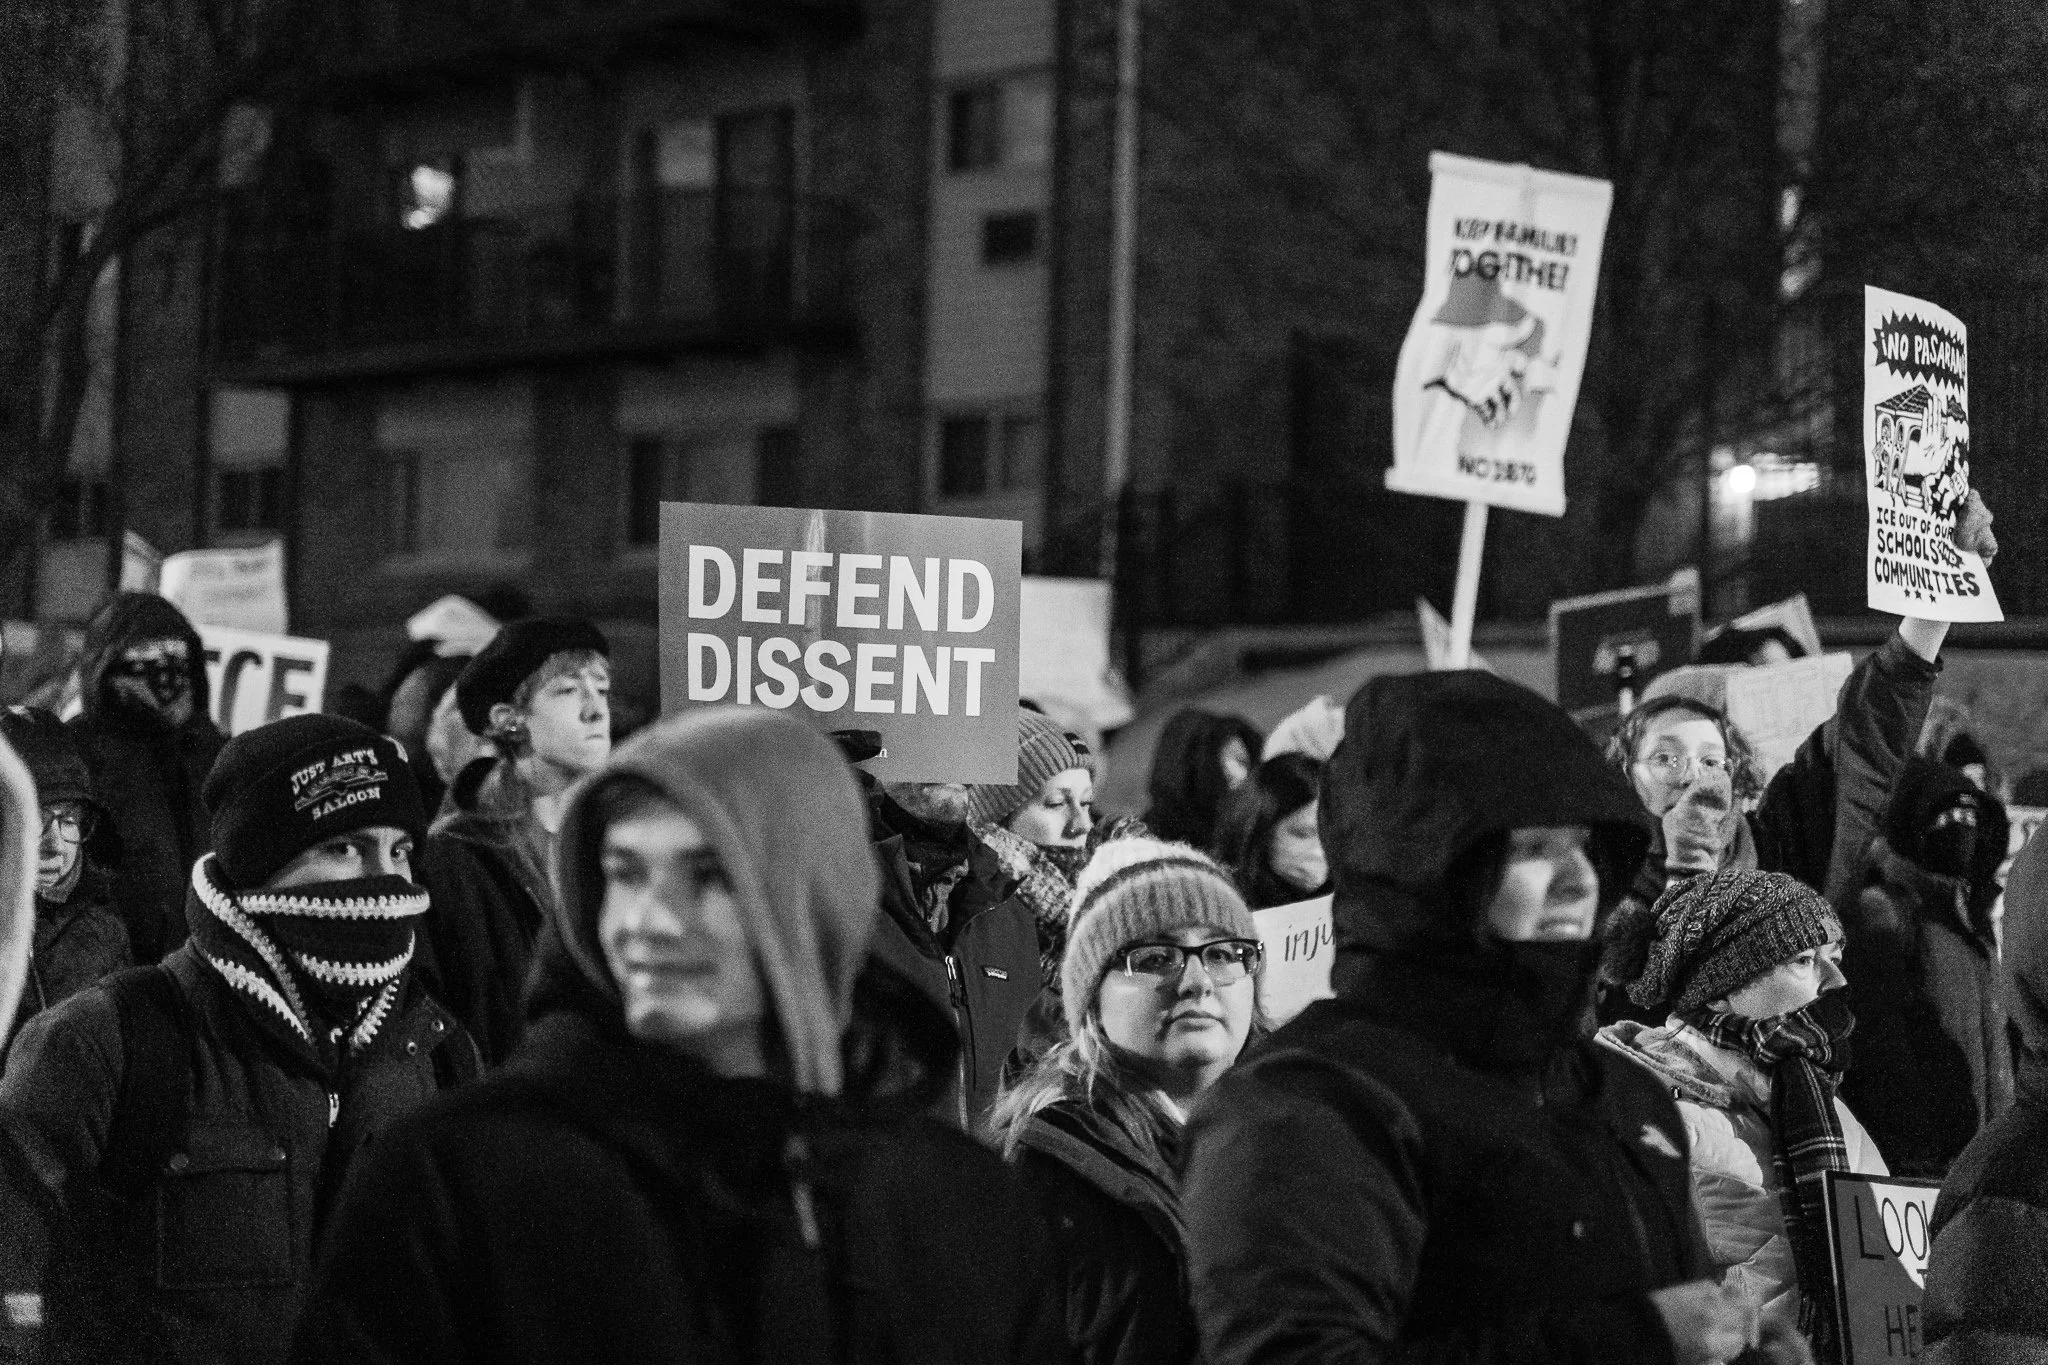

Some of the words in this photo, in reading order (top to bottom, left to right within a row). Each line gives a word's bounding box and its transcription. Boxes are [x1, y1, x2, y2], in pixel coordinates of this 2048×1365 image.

[1458, 456, 1488, 478] NO
[1877, 507, 1896, 526] ICE
[1899, 513, 1918, 530] OUT
[1921, 520, 1931, 534] OF
[1935, 524, 1954, 540] OUR
[1877, 528, 1939, 564] SCHOOLS
[688, 545, 995, 633] DEFEND
[1875, 556, 1980, 596] COMMUNITIES
[687, 632, 996, 716] DISSENT
[291, 762, 326, 796] JUST
[312, 787, 381, 820] SALOON
